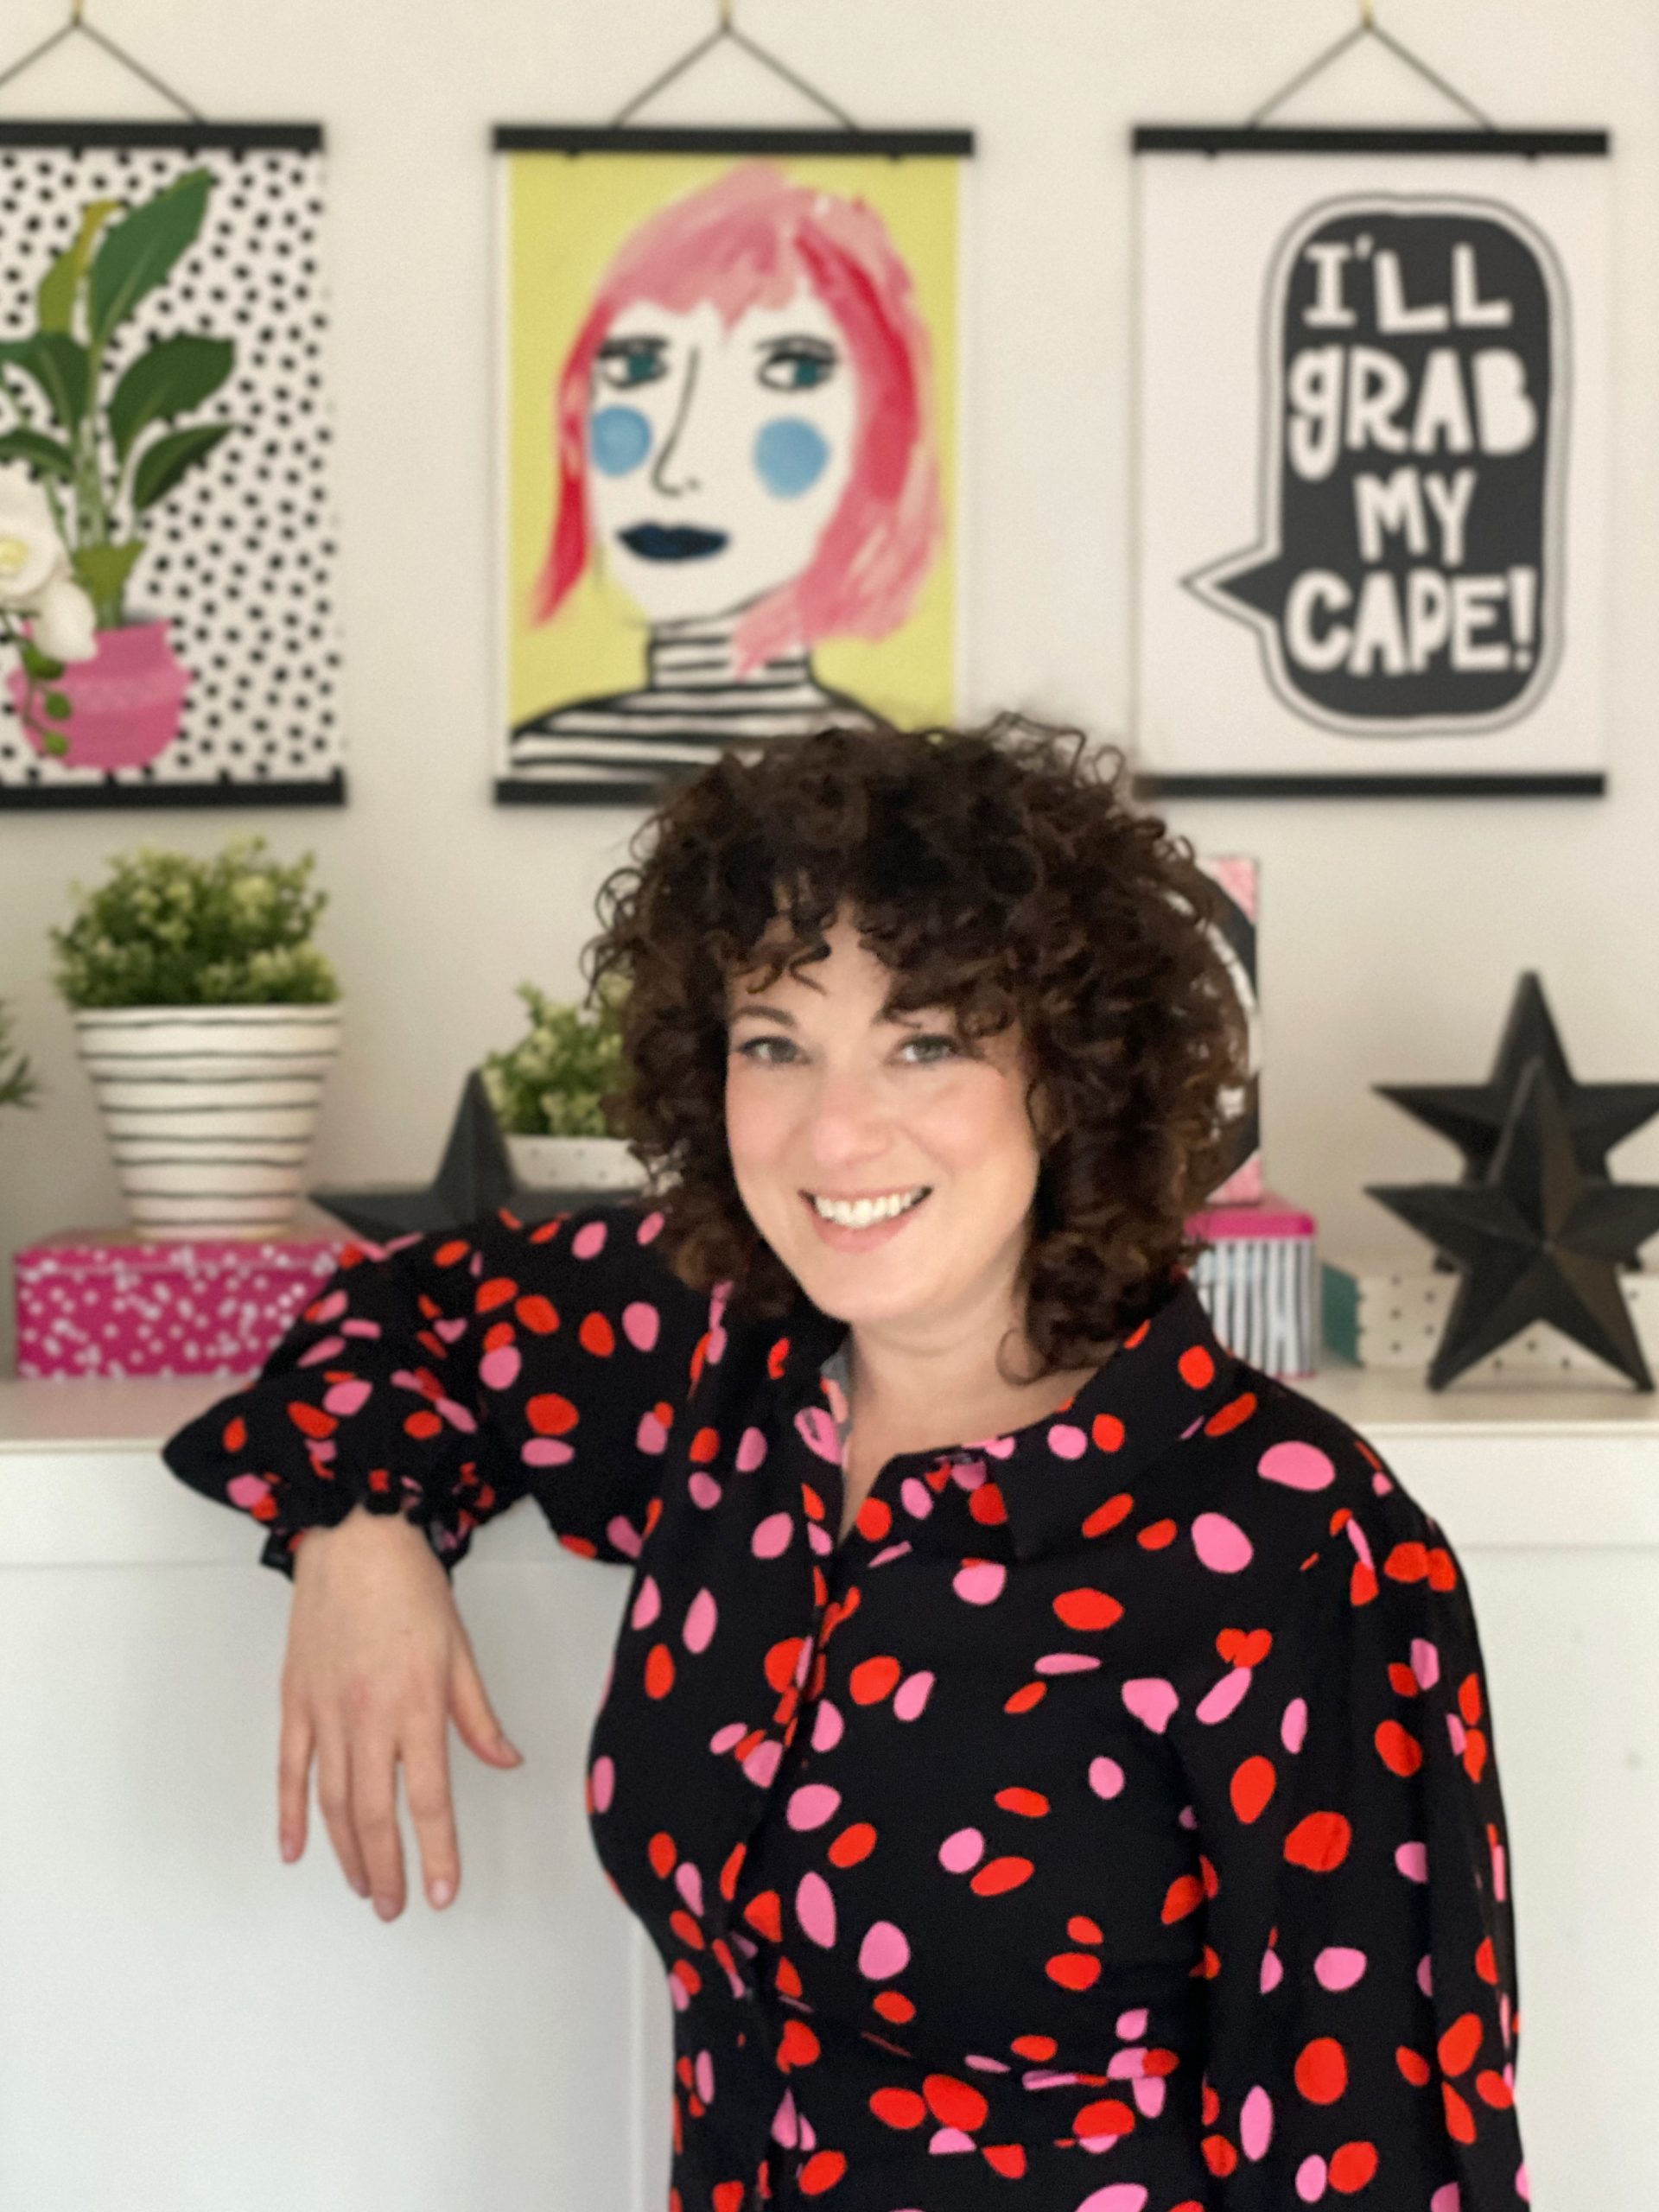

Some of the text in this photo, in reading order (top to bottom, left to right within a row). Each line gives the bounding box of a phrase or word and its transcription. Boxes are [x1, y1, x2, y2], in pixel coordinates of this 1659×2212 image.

[1303, 235, 1512, 334] I'LL
[1354, 467, 1475, 565] MY
[1285, 566, 1536, 676] CAPE!
